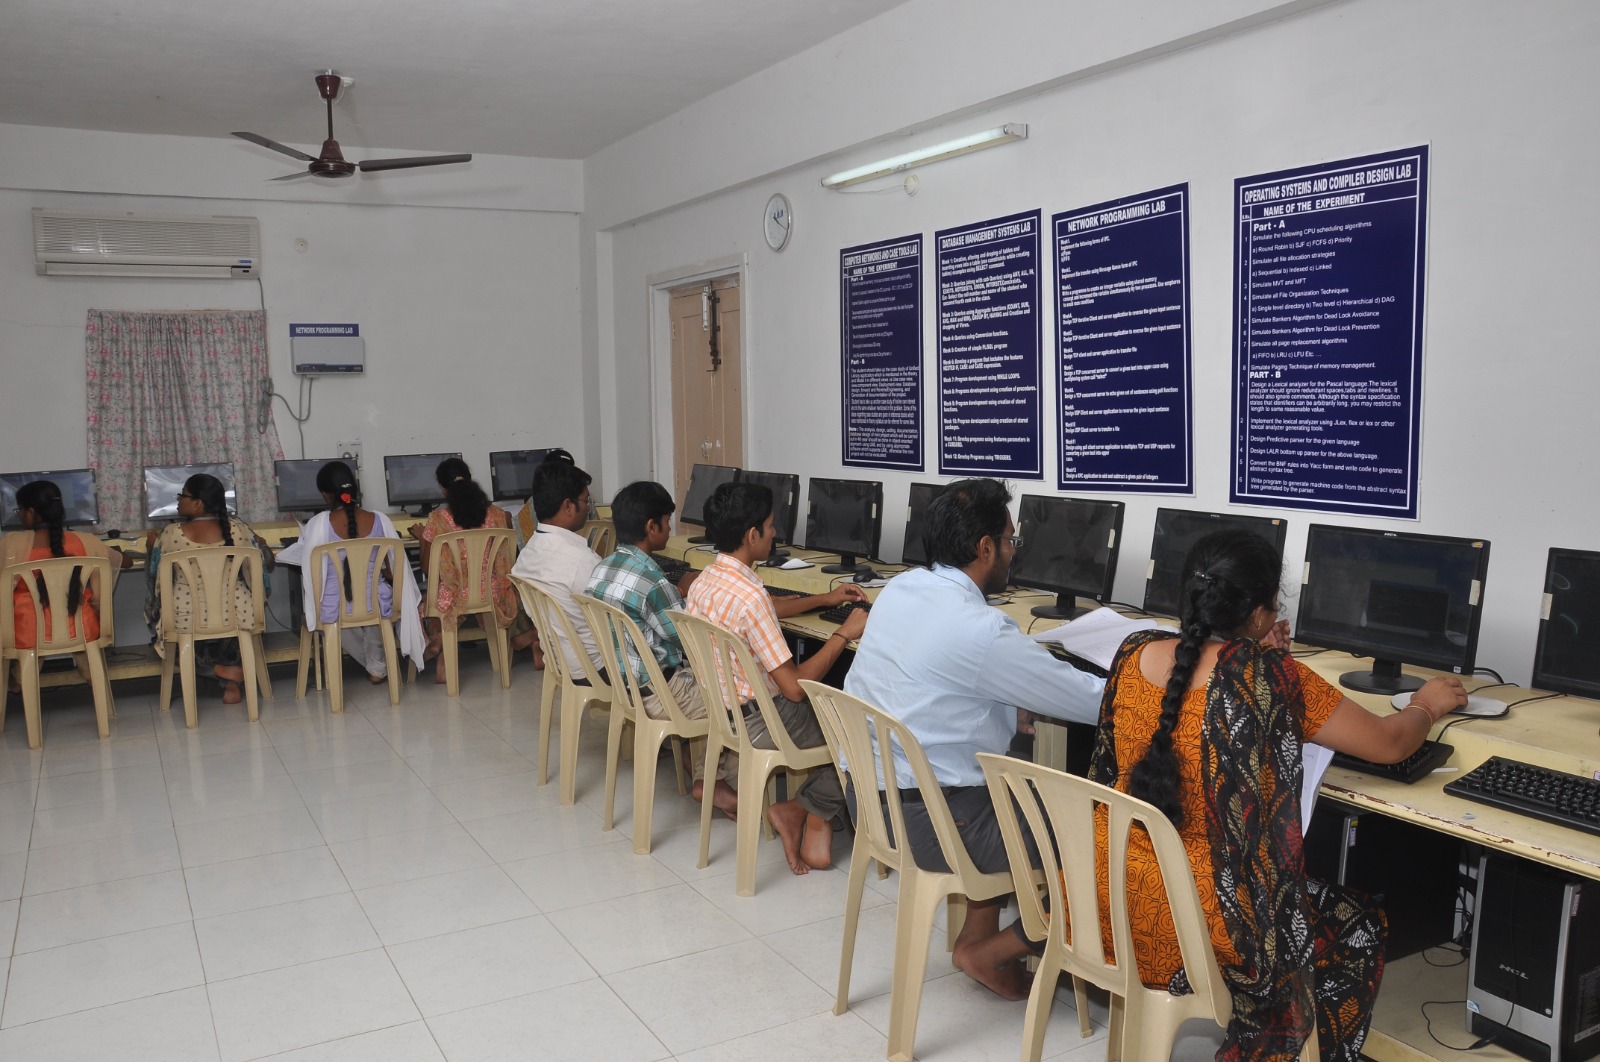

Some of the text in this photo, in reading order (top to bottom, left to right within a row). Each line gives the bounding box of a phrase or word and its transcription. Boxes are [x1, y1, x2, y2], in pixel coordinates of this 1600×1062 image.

[1244, 163, 1412, 204] OPERATING SYSTEMS AND COMPILER DESIGN LAB
[1264, 205, 1284, 217] NAME
[1285, 203, 1295, 214] OF
[1297, 200, 1312, 212] THE
[1316, 192, 1365, 209] EXPERIMENT
[1068, 200, 1166, 233] NETWORK PROGRAMMING LAB
[1253, 233, 1273, 242] Simulate
[1282, 229, 1303, 239] following
[1316, 224, 1344, 235] scheduling
[1344, 221, 1372, 231] algorithms
[1254, 221, 1272, 232] Part
[1279, 219, 1286, 229] A
[942, 221, 1031, 249] DATABASE MANAGEMENT SYSTEMS LAB
[1258, 244, 1274, 253] Round
[1312, 238, 1327, 246] FCFS
[1334, 236, 1352, 245] Priority
[845, 255, 861, 266] COMPUTER
[862, 251, 882, 263] NETWORKS
[882, 250, 890, 260] AND
[890, 248, 898, 258] CASE
[898, 245, 910, 257] TOOLS
[1252, 257, 1272, 265] Simulate
[1288, 253, 1311, 262] allocation
[1311, 251, 1336, 260] strategies
[876, 262, 898, 272] EXPERIMENT
[1258, 268, 1282, 277] Sequential
[1289, 289, 1320, 299] Organization
[1320, 286, 1349, 296] Techniques
[1257, 305, 1272, 313] Single
[1284, 302, 1305, 311] directory
[1342, 298, 1373, 306] Hierarchical
[1292, 314, 1316, 323] Algorithm
[1292, 326, 1315, 335] Algorithm
[1351, 323, 1380, 331] Prevention
[1322, 338, 1348, 346] algorithms
[1336, 439, 1360, 447] language
[1499, 964, 1528, 980] HCL
